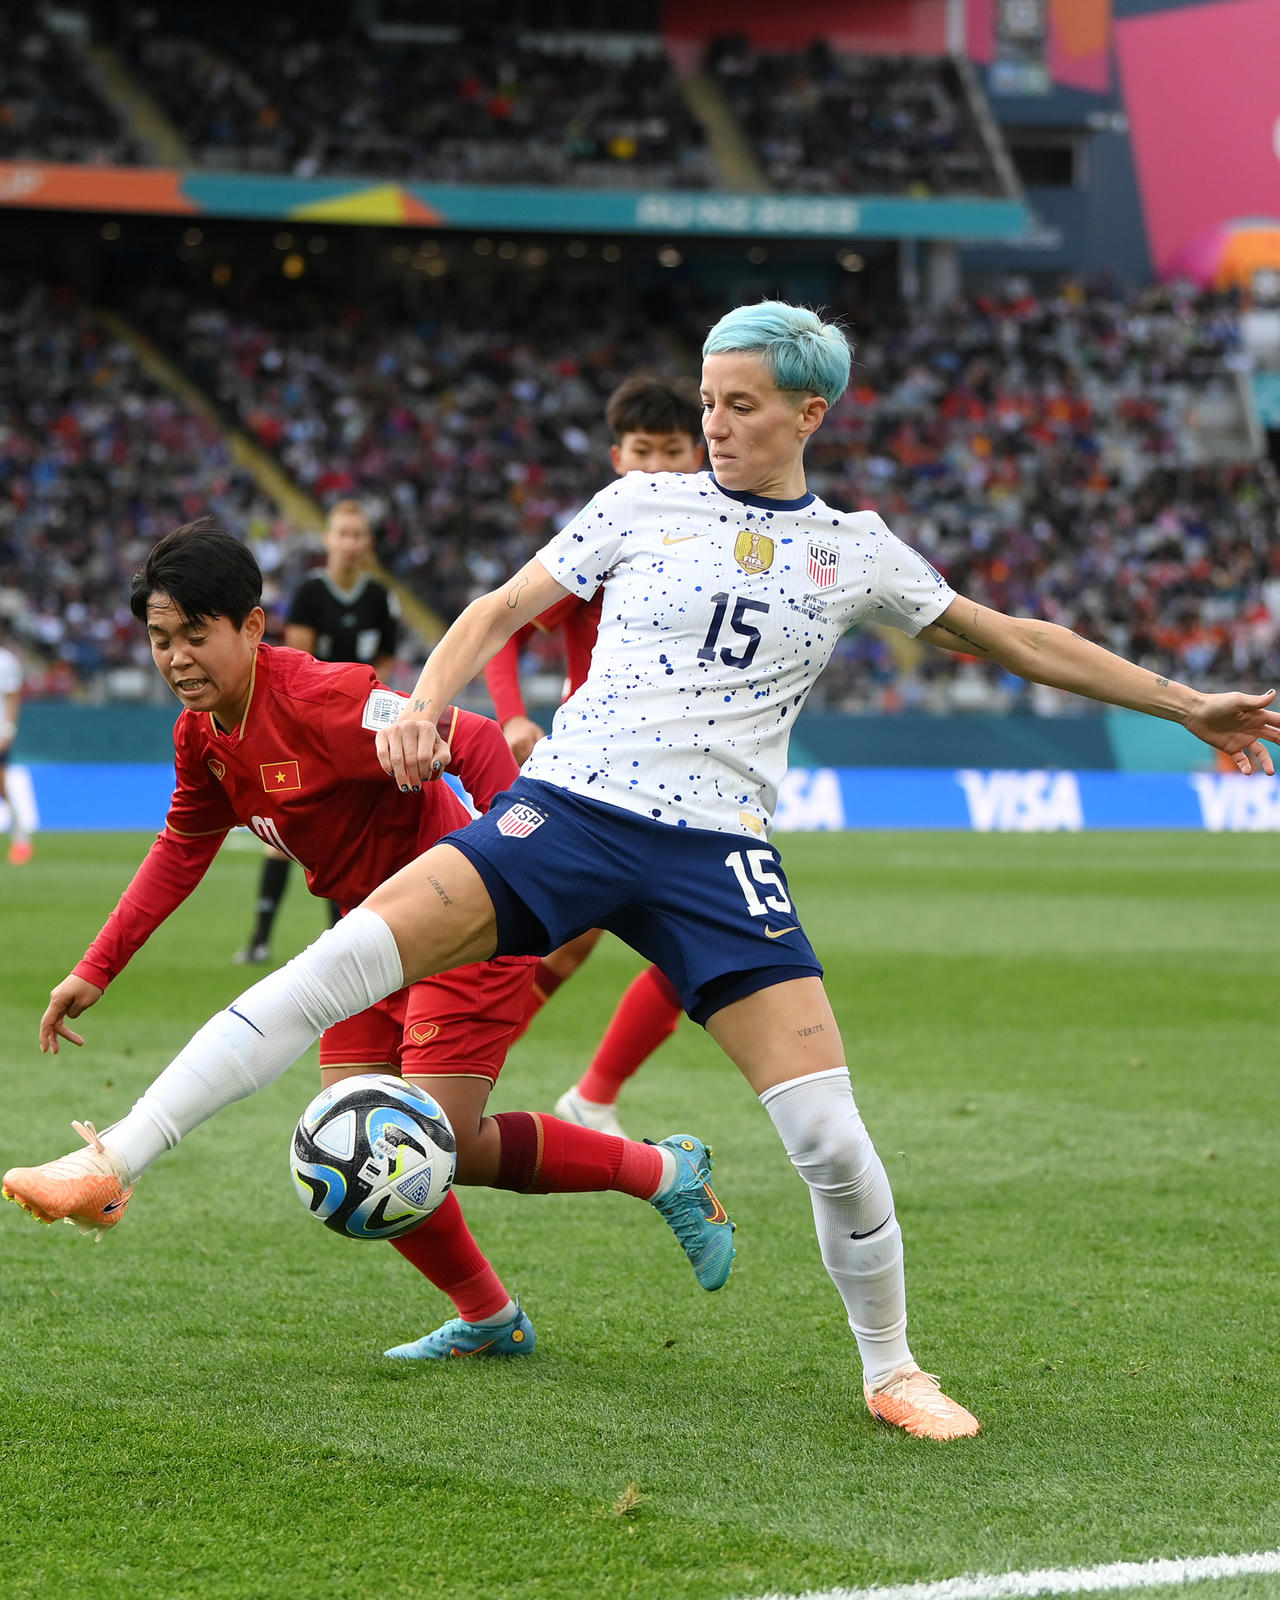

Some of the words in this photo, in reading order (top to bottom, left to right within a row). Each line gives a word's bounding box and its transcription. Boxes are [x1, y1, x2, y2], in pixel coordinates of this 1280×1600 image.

[743, 555, 763, 567] FIFA
[810, 546, 837, 566] USA
[697, 592, 770, 670] 15
[372, 698, 383, 722] FOOTBALL
[380, 698, 393, 723] UNITES
[511, 805, 542, 826] USA
[772, 768, 847, 832] SA
[955, 768, 1085, 832] VISA
[1190, 771, 1280, 833] VIS
[724, 849, 792, 917] 15
